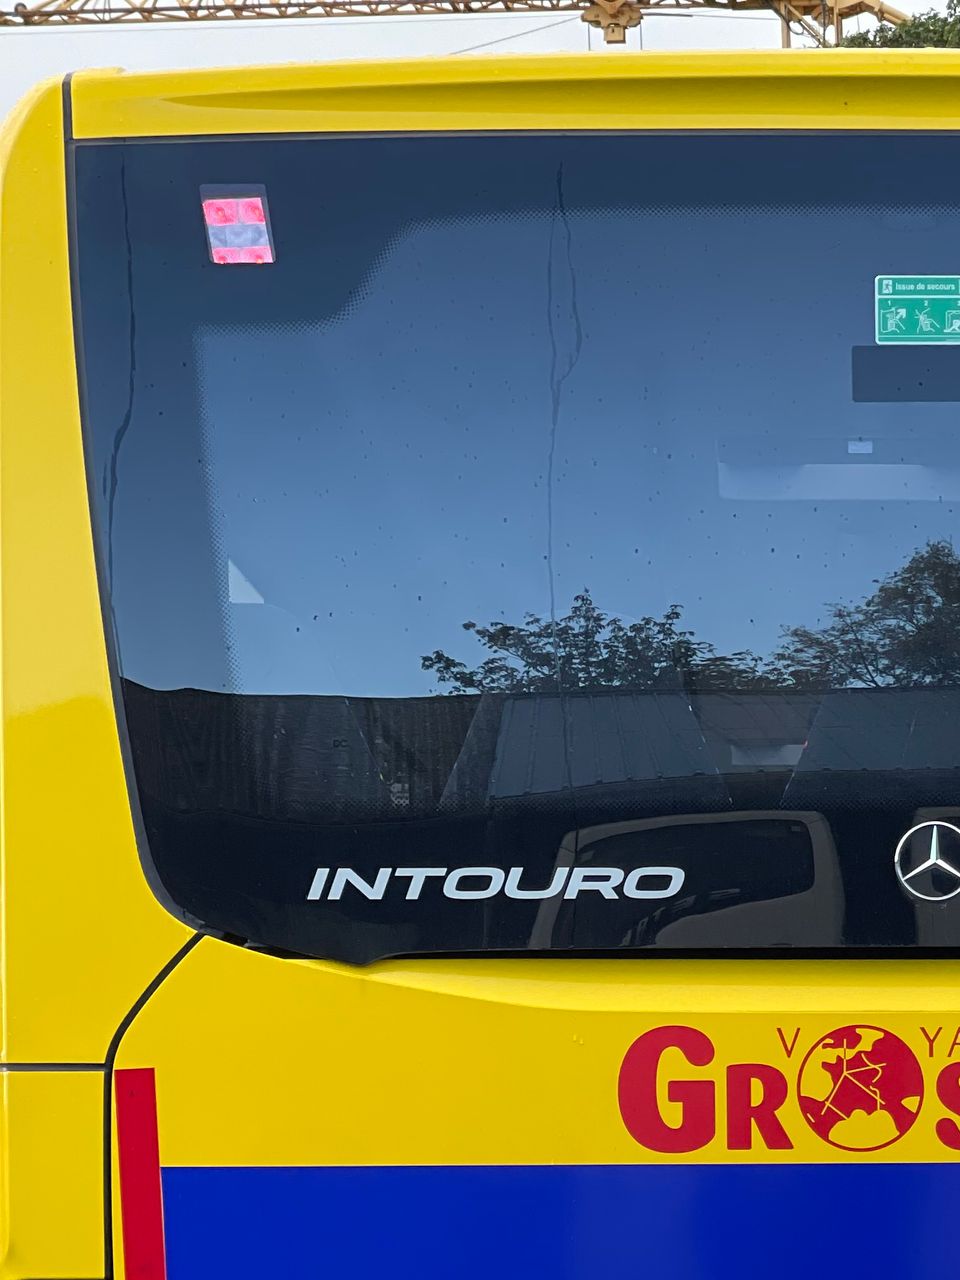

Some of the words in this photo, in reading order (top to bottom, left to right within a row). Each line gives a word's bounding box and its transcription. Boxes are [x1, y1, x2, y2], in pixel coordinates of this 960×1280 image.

[916, 282, 926, 290] de
[926, 283, 956, 291] secours
[306, 866, 686, 901] INTOURO
